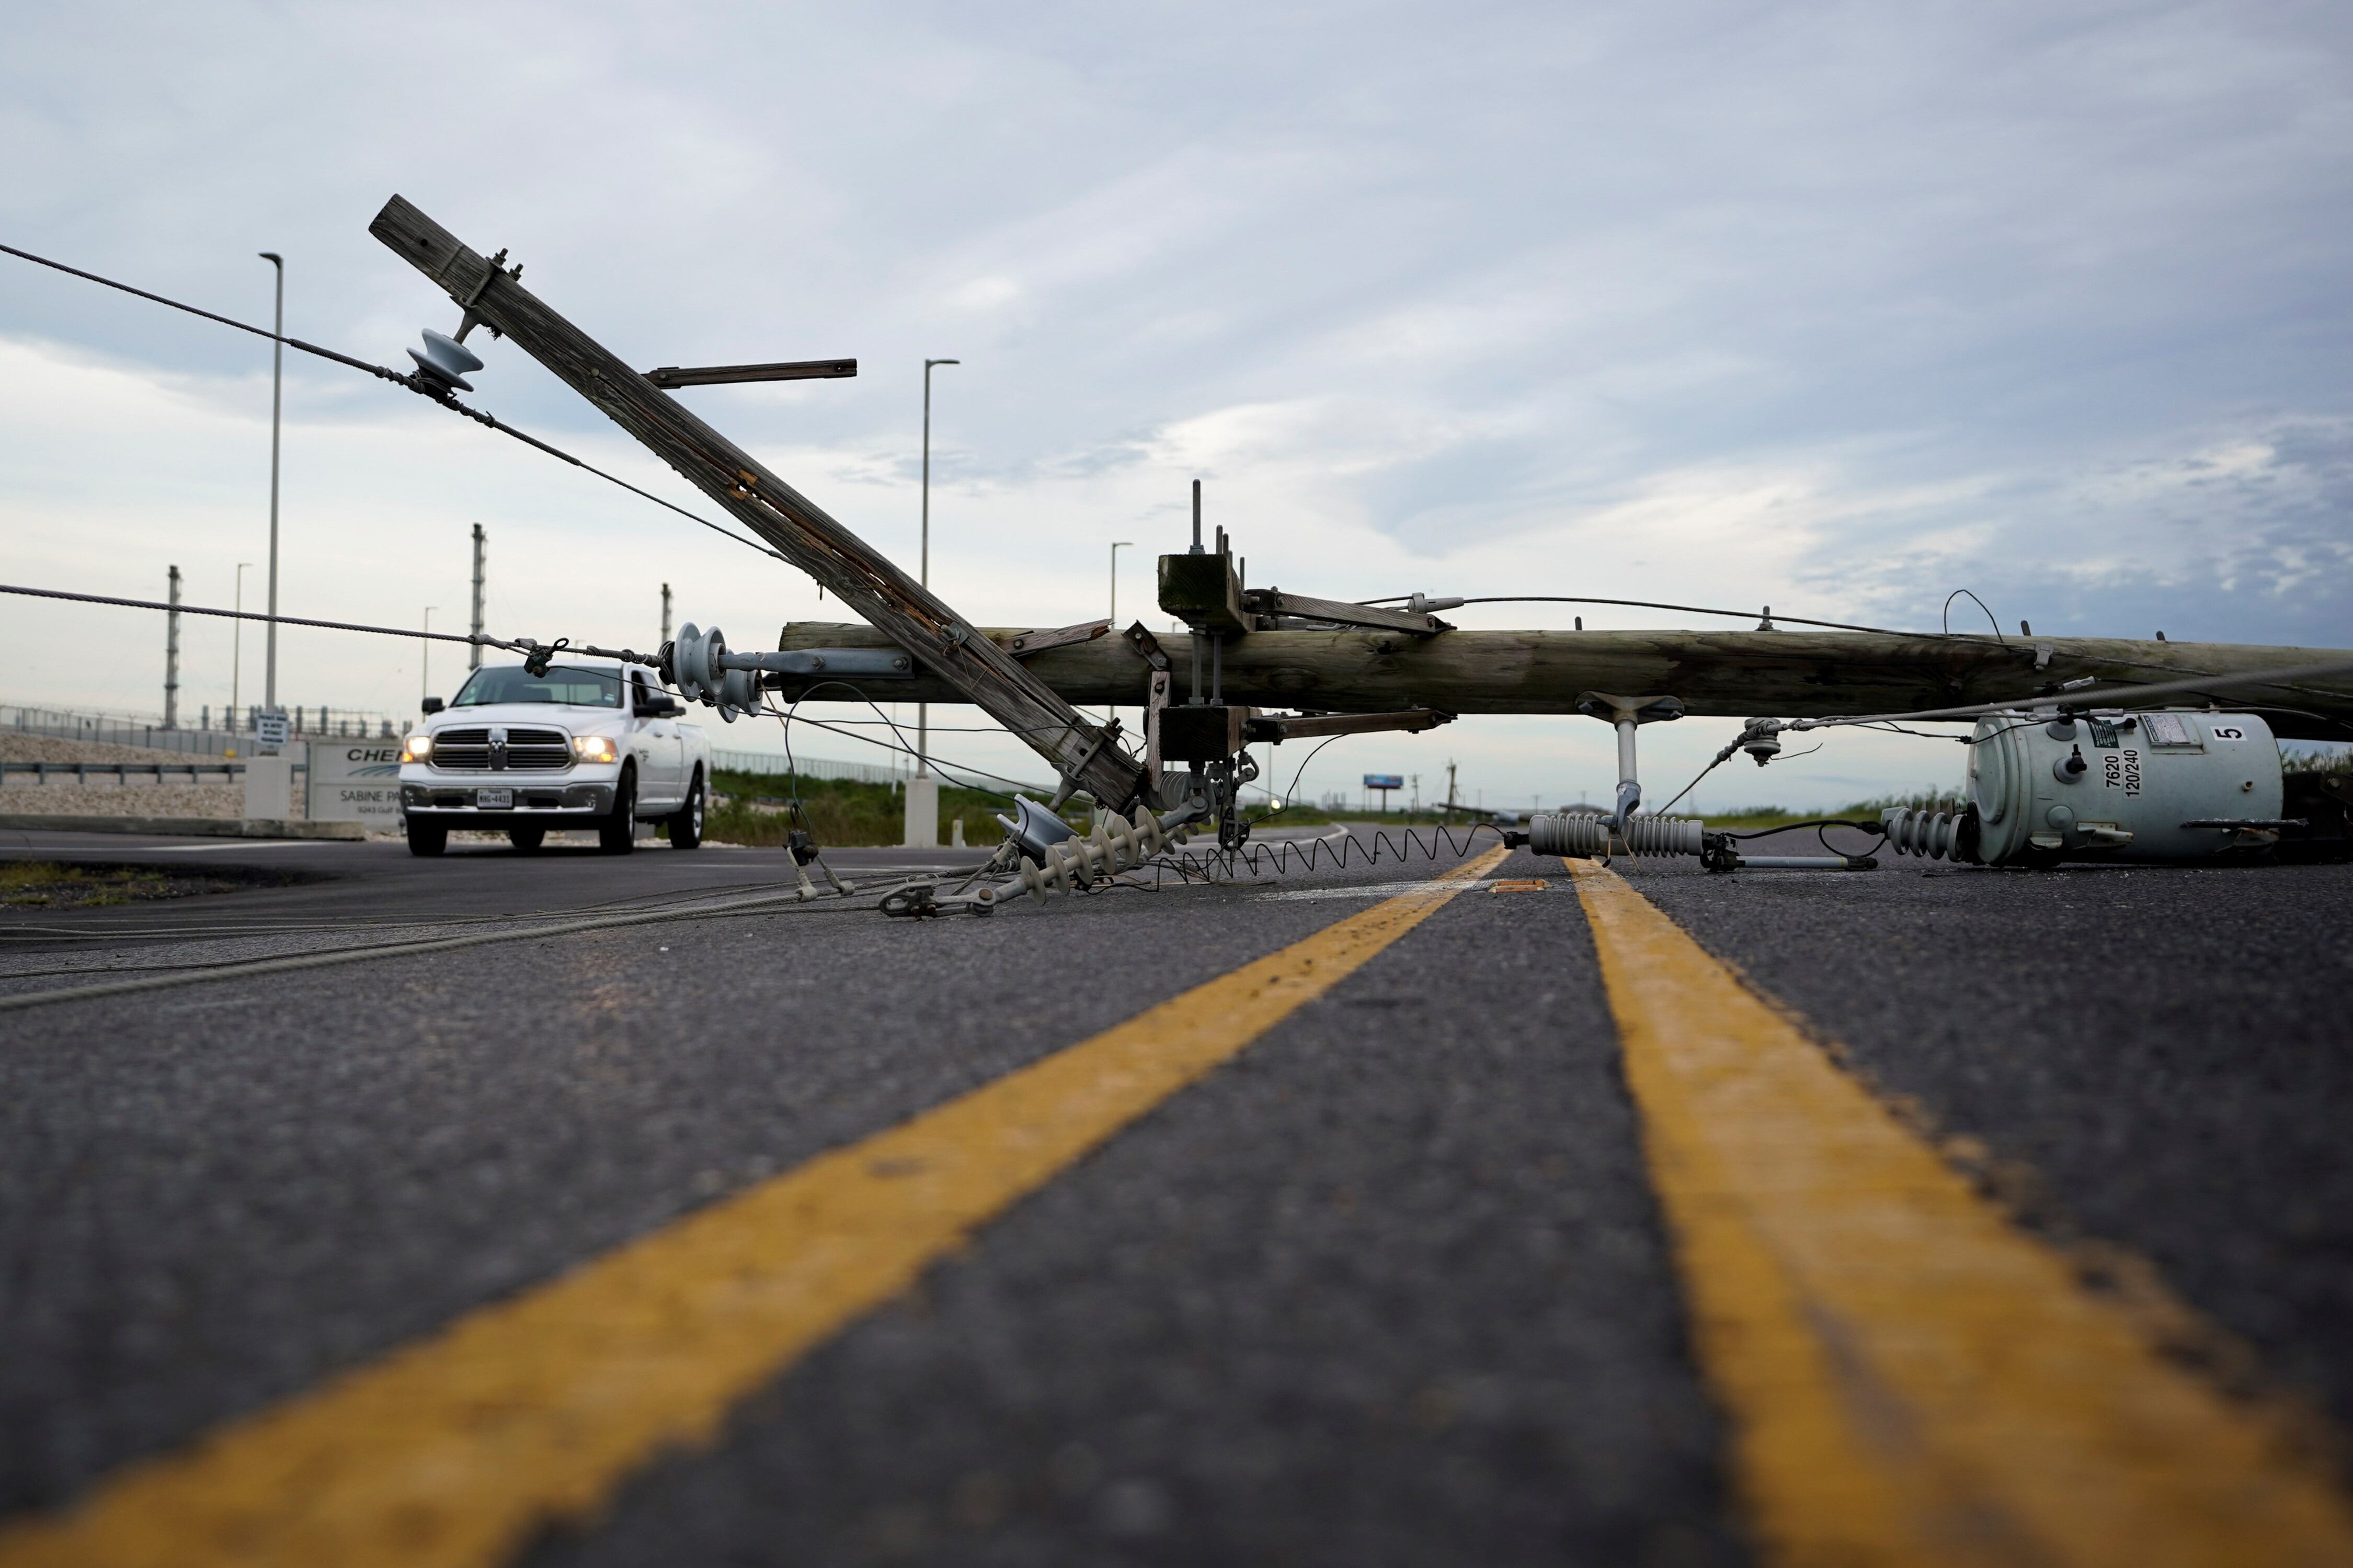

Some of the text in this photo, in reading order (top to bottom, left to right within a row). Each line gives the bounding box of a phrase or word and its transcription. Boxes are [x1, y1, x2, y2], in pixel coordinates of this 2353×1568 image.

[2214, 728, 2242, 739] 5
[2105, 756, 2120, 788] 7620
[2123, 750, 2140, 797] 120/240
[340, 790, 383, 802] SABINE
